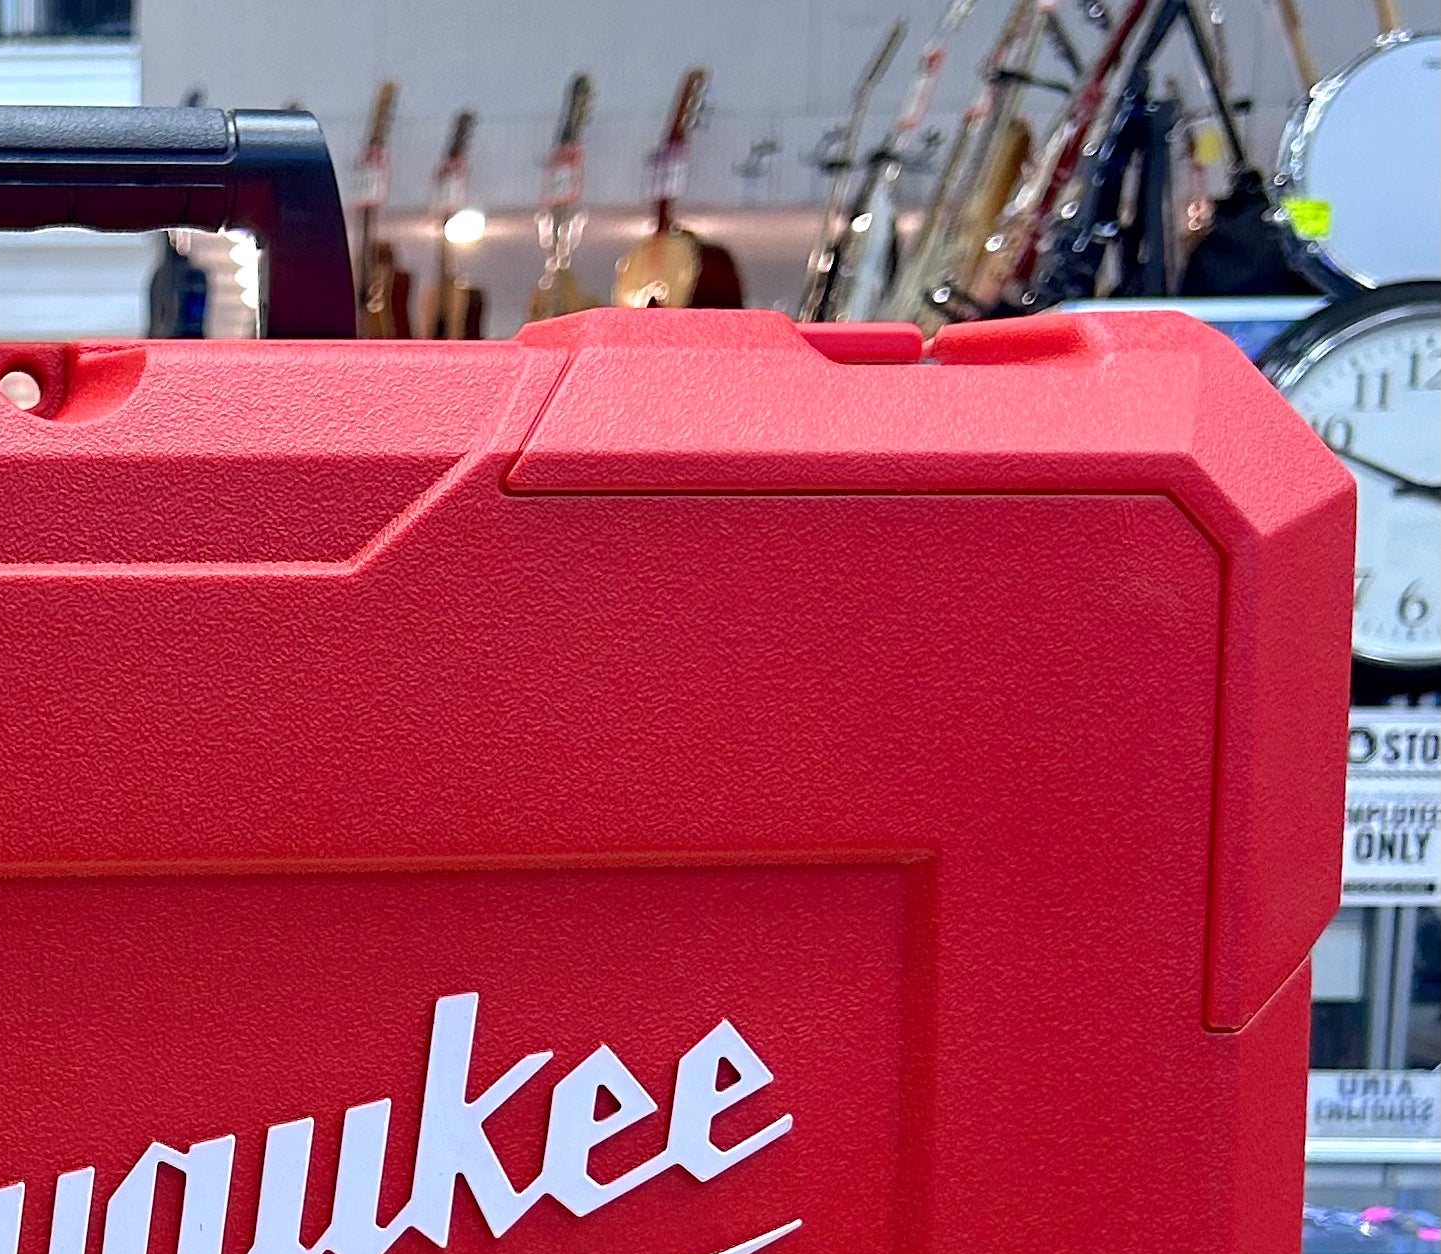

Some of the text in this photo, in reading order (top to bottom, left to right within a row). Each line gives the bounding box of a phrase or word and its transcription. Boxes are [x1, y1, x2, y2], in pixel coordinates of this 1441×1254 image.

[1356, 369, 1391, 411] 11
[1397, 578, 1430, 629] 6
[1354, 830, 1430, 862] ONLY
